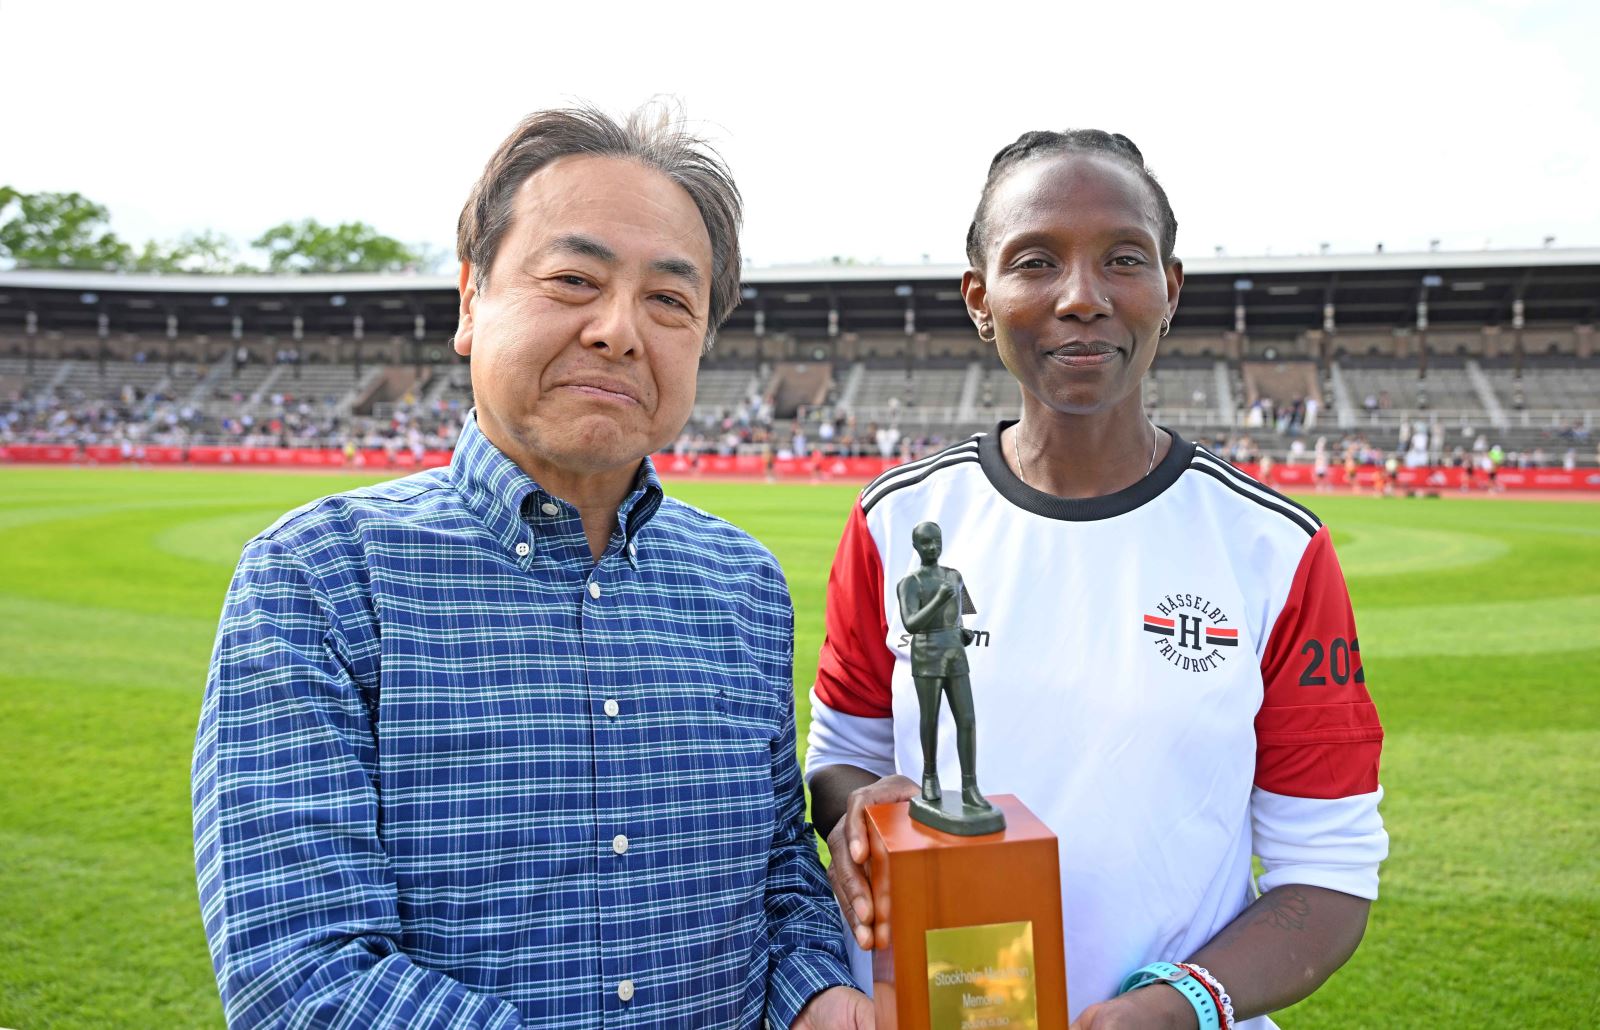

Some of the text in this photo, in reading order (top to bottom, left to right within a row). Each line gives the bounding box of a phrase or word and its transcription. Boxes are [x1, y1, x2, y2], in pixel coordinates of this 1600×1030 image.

[1156, 593, 1228, 625] HÄSSELBY
[1178, 613, 1202, 651] H
[1154, 637, 1226, 673] FRIIDROTT
[984, 966, 1029, 981] Maaon
[962, 992, 1005, 1008] Memor
